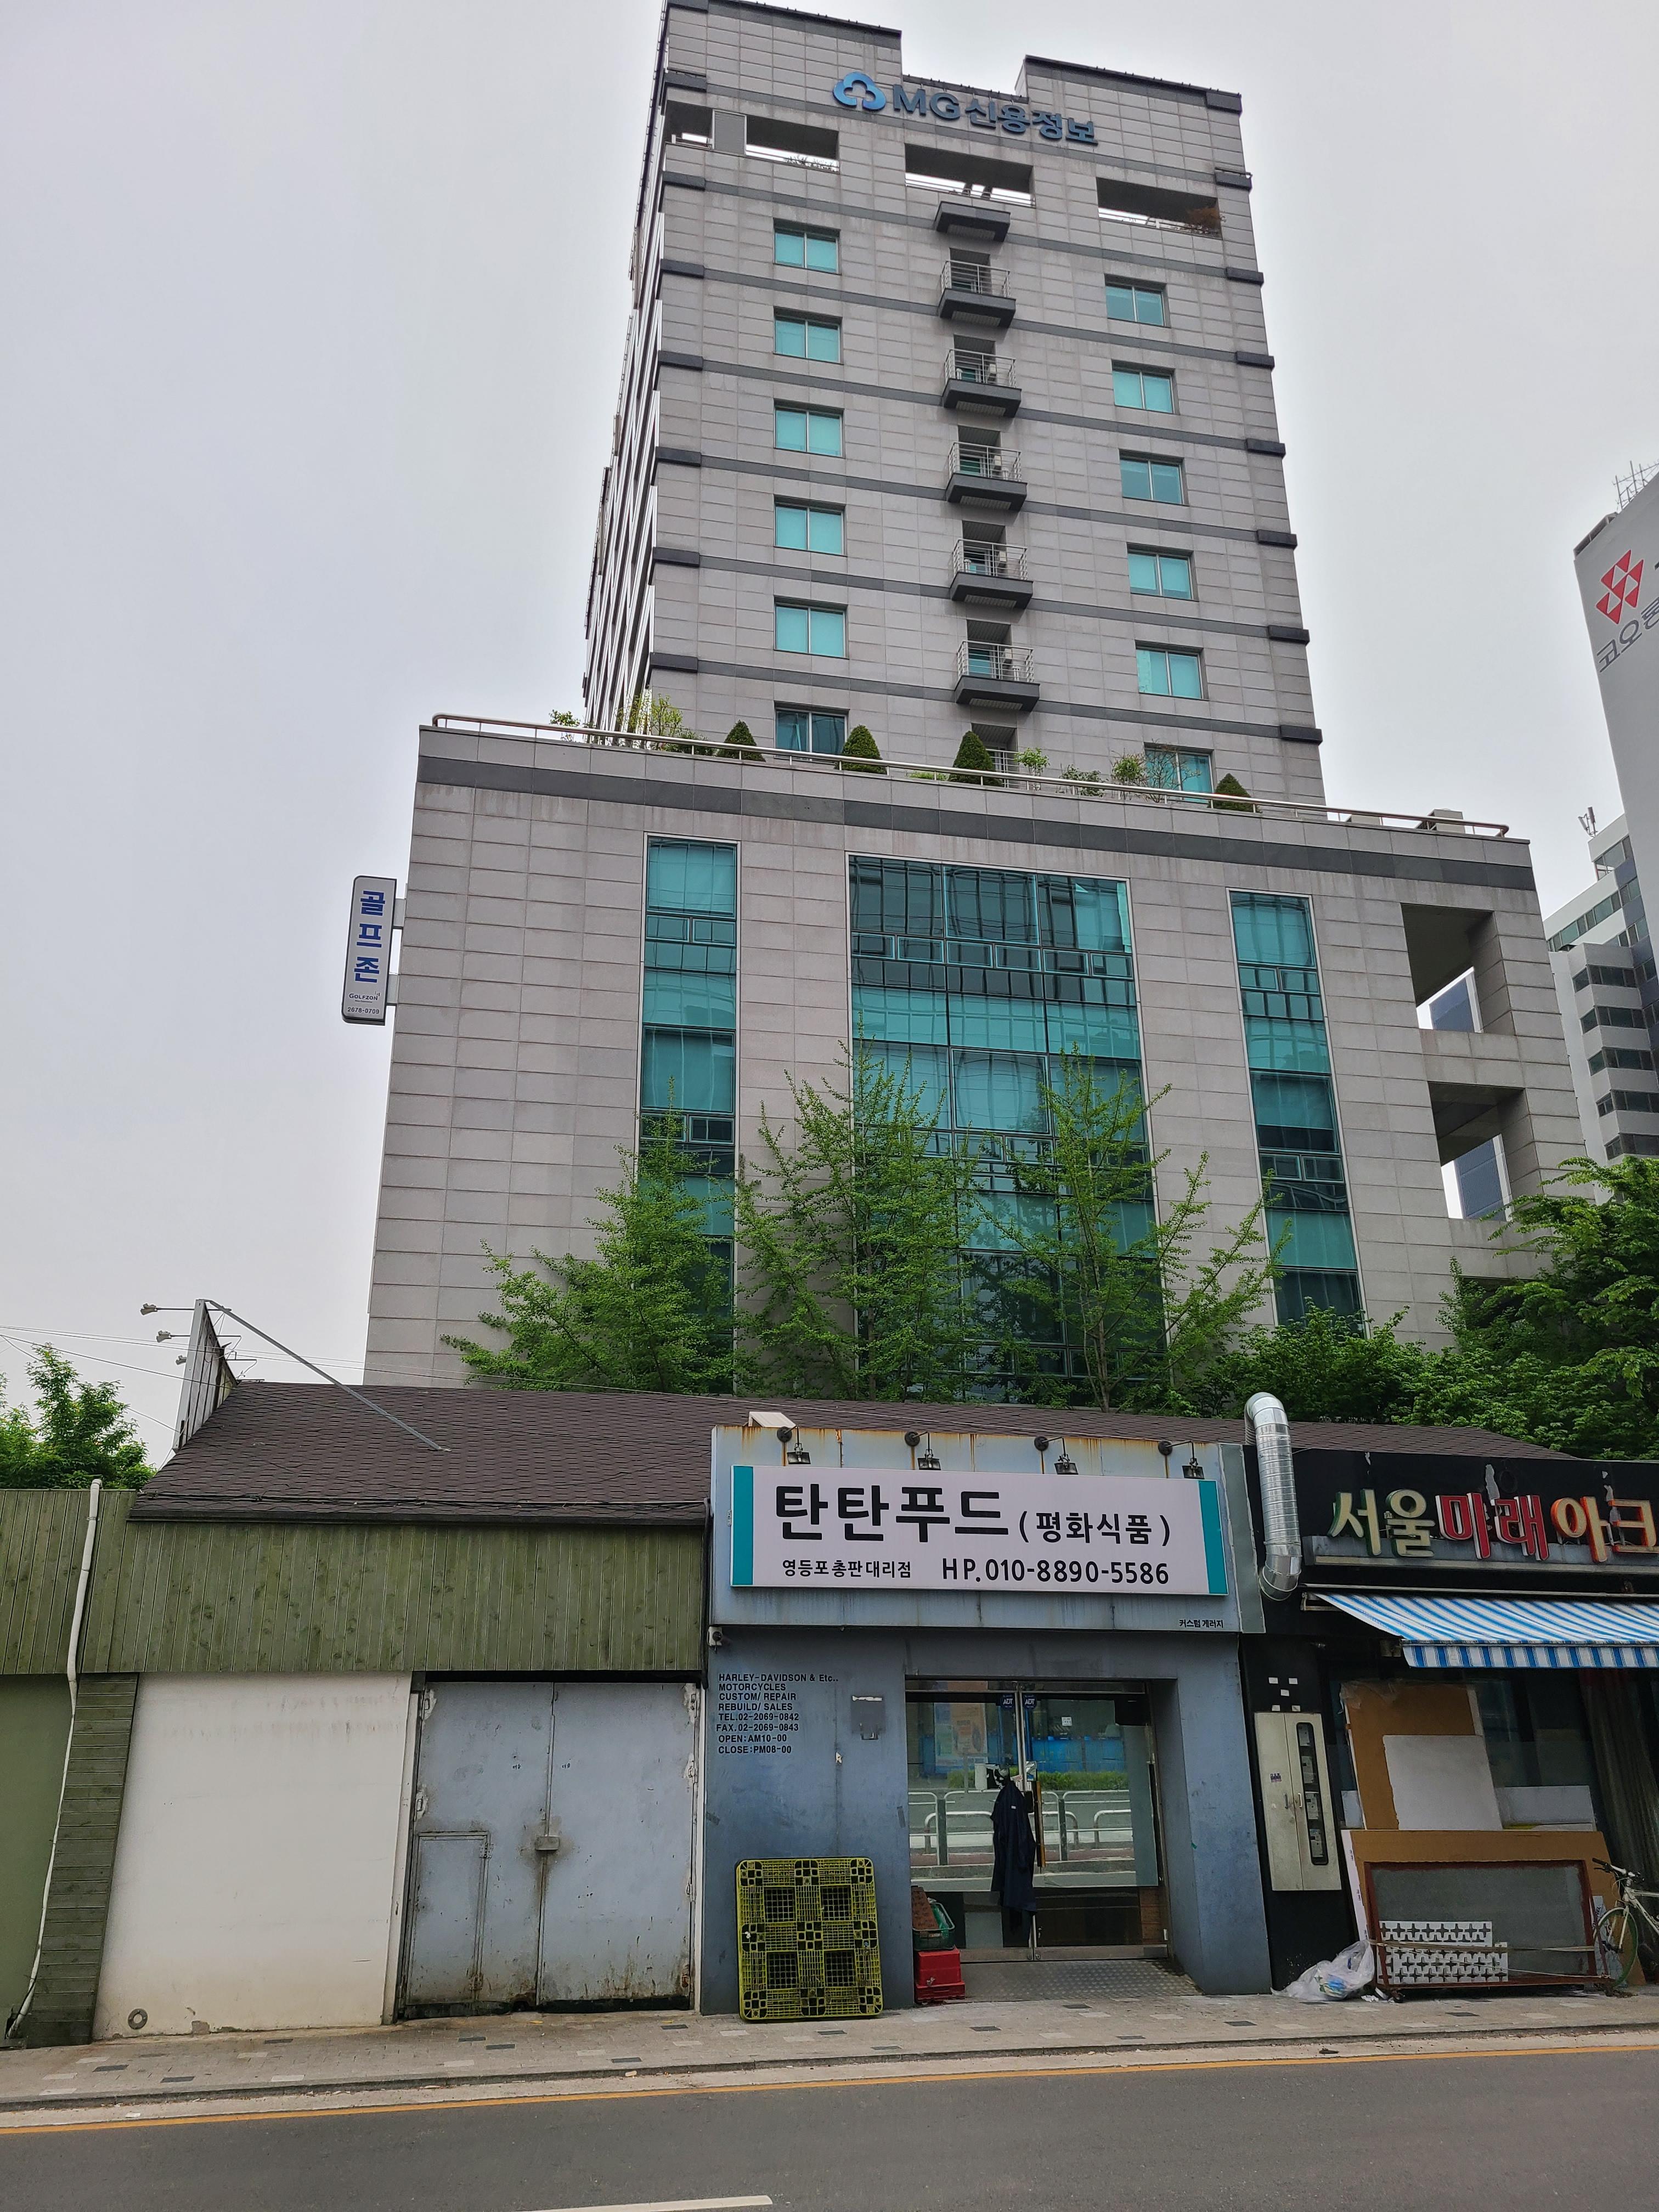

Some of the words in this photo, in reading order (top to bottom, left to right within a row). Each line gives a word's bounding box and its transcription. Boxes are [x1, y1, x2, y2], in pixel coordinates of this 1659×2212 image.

[892, 84, 1098, 145] MG신용정보
[354, 890, 386, 984] 골프존
[776, 1483, 1009, 1543] 탄탄푸드
[1019, 1511, 1171, 1547] (평화식품)
[1179, 1620, 1201, 1628] 커스텀
[1201, 1620, 1223, 1628] 게러지
[719, 1692, 760, 1701] CUSTOM/
[718, 1703, 760, 1711] REBUILD/
[718, 1713, 799, 1721] TEL.02-2069-0842
[716, 1723, 799, 1731] FAX.02-2069-0843
[718, 1734, 787, 1742] OPEN:AM10-00
[718, 1745, 792, 1753] CLOSE:PM08-00
